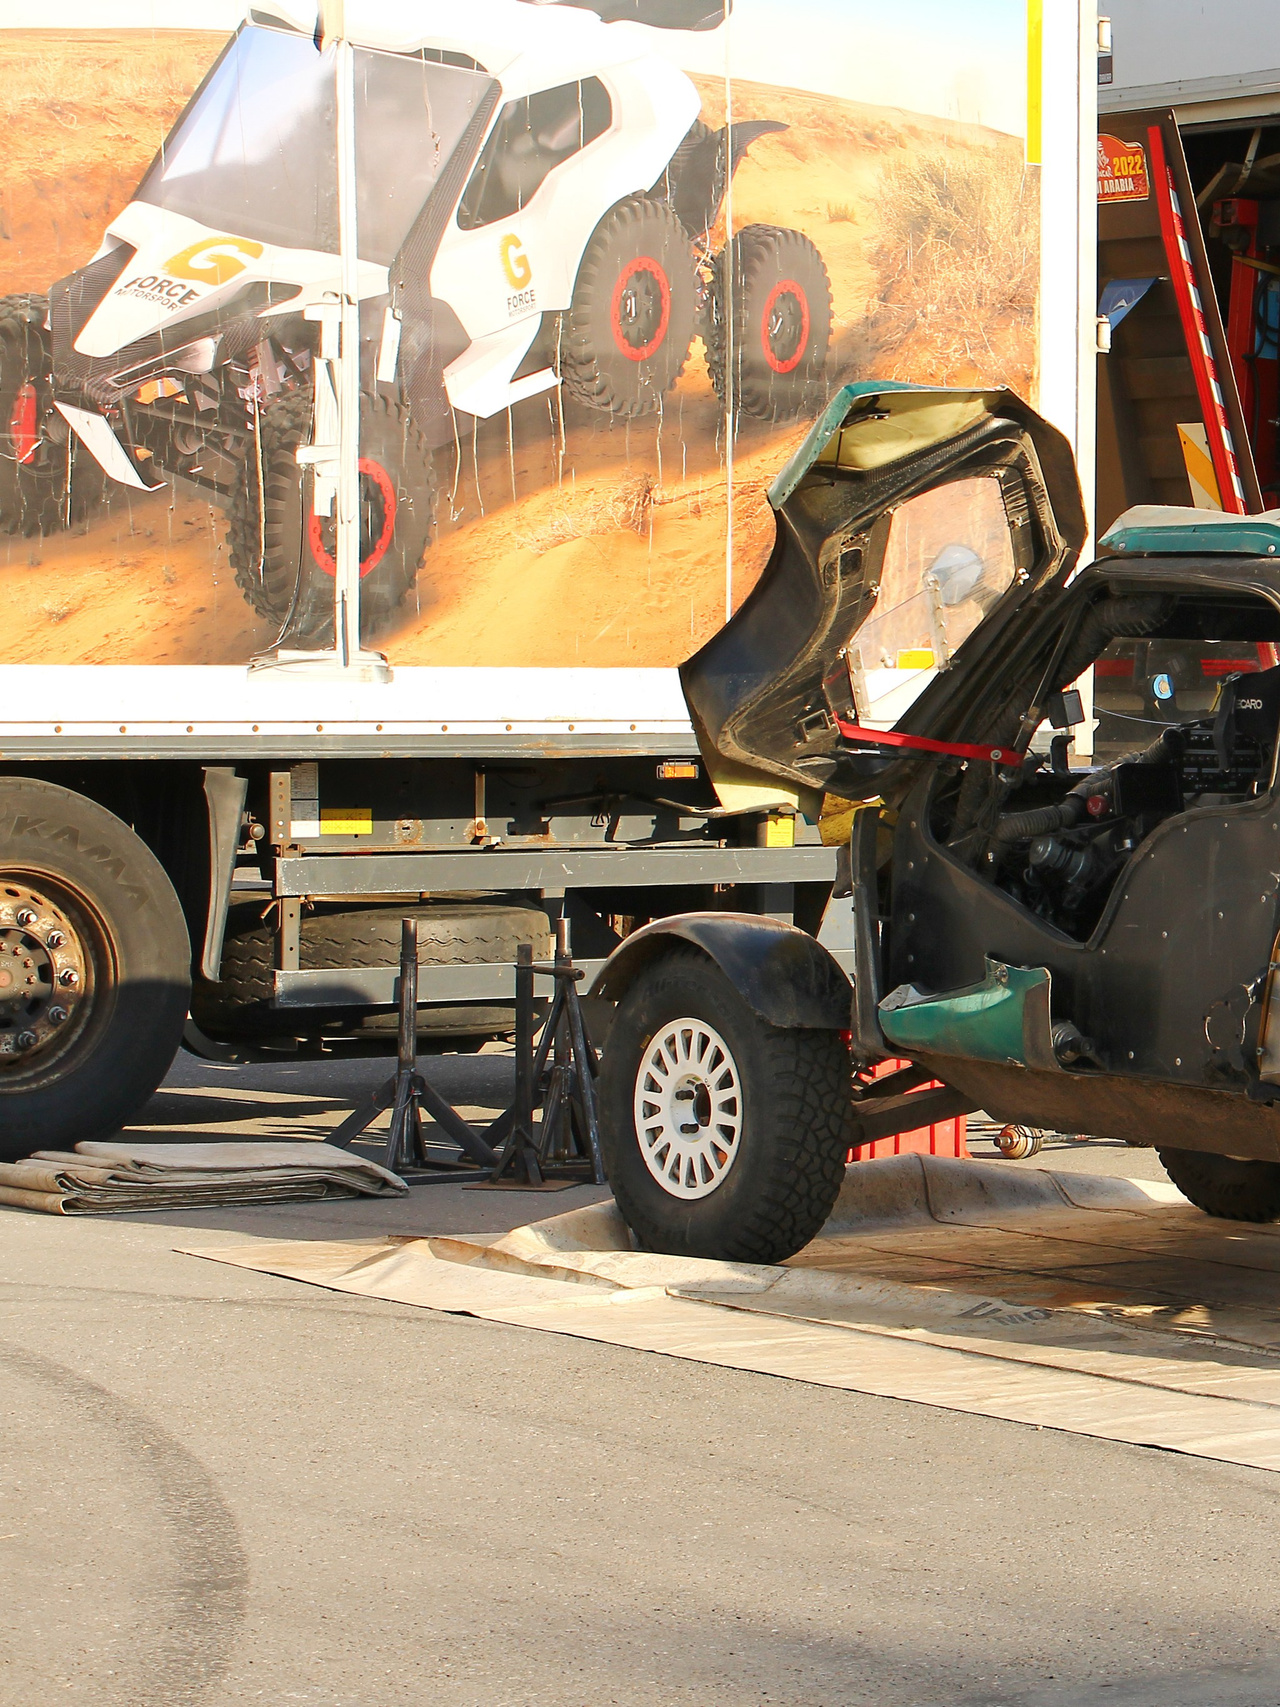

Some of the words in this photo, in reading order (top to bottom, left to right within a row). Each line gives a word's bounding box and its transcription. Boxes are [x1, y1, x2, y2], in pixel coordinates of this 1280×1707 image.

[1113, 155, 1143, 177] 2022
[1104, 178, 1135, 194] ARABIA
[160, 236, 263, 287] G
[499, 232, 533, 291] G
[114, 288, 187, 312] MTORSPOR
[124, 275, 201, 305] FORCE
[507, 289, 537, 310] FORCE
[1235, 699, 1263, 710] ECARO
